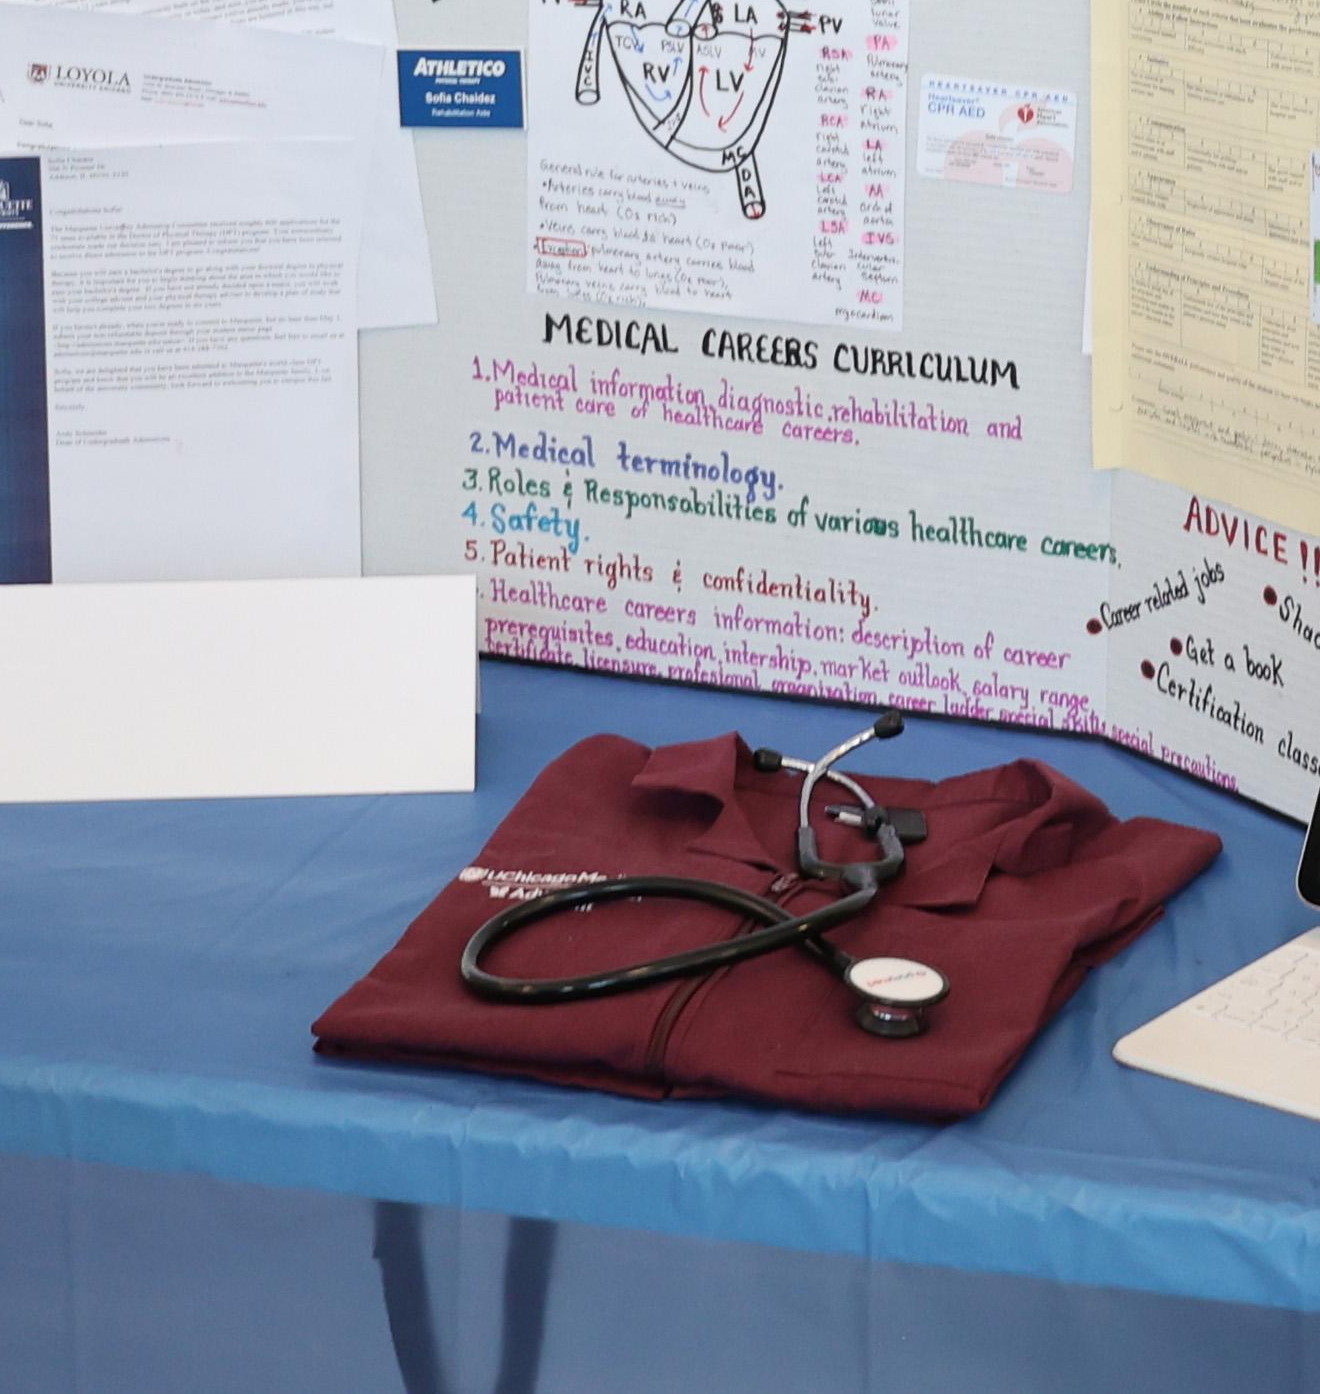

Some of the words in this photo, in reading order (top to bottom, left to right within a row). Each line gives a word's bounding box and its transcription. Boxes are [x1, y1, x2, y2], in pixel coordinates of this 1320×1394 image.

[734, 3, 758, 25] LA
[818, 15, 843, 33] PV
[56, 65, 131, 87] LOYOLA
[413, 57, 506, 77] ATHLETICO
[643, 62, 670, 84] RV
[716, 69, 745, 93] LV
[425, 91, 452, 104] Sofia
[928, 102, 955, 114] CPR
[959, 105, 986, 119] AED
[542, 312, 679, 355] MEDICAL
[701, 327, 819, 370] CAREERS
[833, 342, 1020, 390] CURRICULUM
[494, 386, 565, 411] patient
[575, 399, 615, 417] care
[631, 401, 648, 419] of
[663, 403, 764, 436] healthcare
[782, 421, 860, 446] careers.
[986, 415, 1023, 440] and
[493, 431, 596, 468] Medical
[617, 441, 784, 503] terminology.
[488, 467, 551, 498] Roles
[787, 495, 809, 527] of
[815, 508, 900, 538] various
[909, 510, 1027, 552] healthcare
[490, 502, 590, 555] Safety.
[1183, 495, 1289, 565] ADVICE
[490, 538, 572, 573] Patient
[584, 553, 654, 591] rights
[703, 566, 879, 619] confidentiality.
[1100, 601, 1141, 631] Career
[1145, 570, 1191, 615] related
[1193, 557, 1226, 605] jobs
[490, 578, 608, 613] Healthcare
[625, 598, 697, 626] careers
[714, 603, 845, 643] information:
[851, 614, 966, 659] description
[974, 630, 995, 660] of
[1003, 646, 1072, 670] career
[820, 656, 891, 683] market
[972, 672, 1029, 709] salary
[1186, 634, 1215, 666] Get
[1224, 653, 1236, 672] a
[1243, 645, 1285, 687] book
[1157, 662, 1265, 745] Certification
